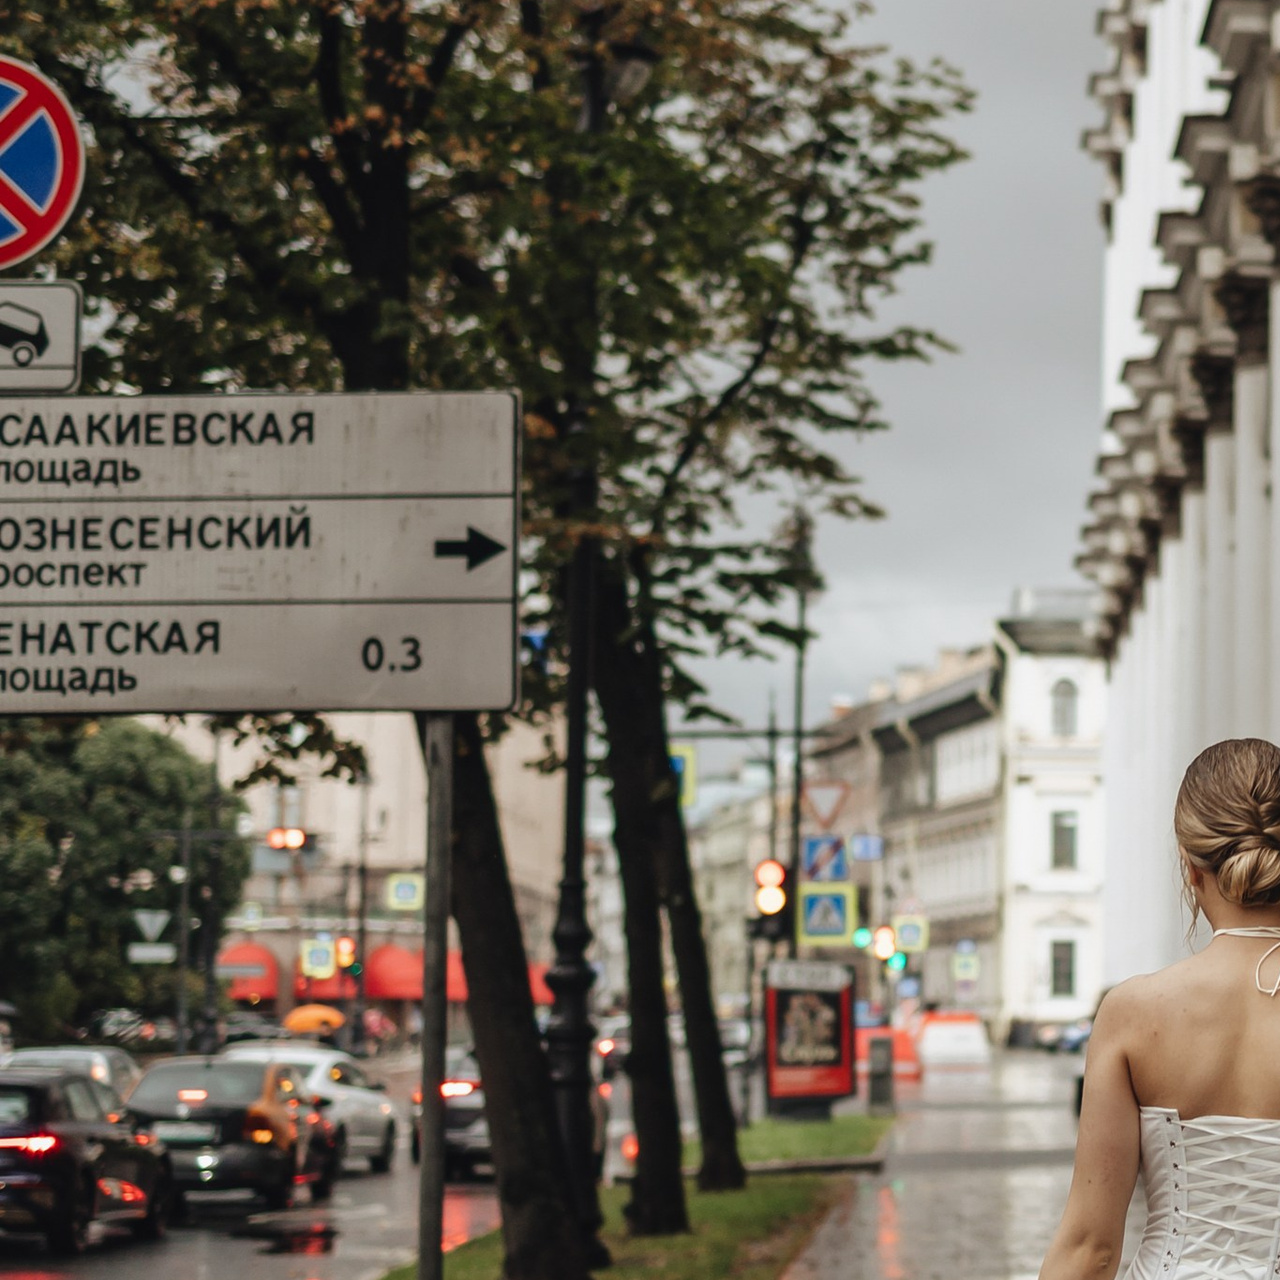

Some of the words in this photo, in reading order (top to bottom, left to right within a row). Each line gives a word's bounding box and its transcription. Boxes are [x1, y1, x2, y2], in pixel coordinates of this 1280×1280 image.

[0, 411, 314, 446] СААКИЕВСКАЯ
[0, 505, 311, 551] ОЗНЕСЕНСКИЙ
[362, 636, 422, 672] 0.3
